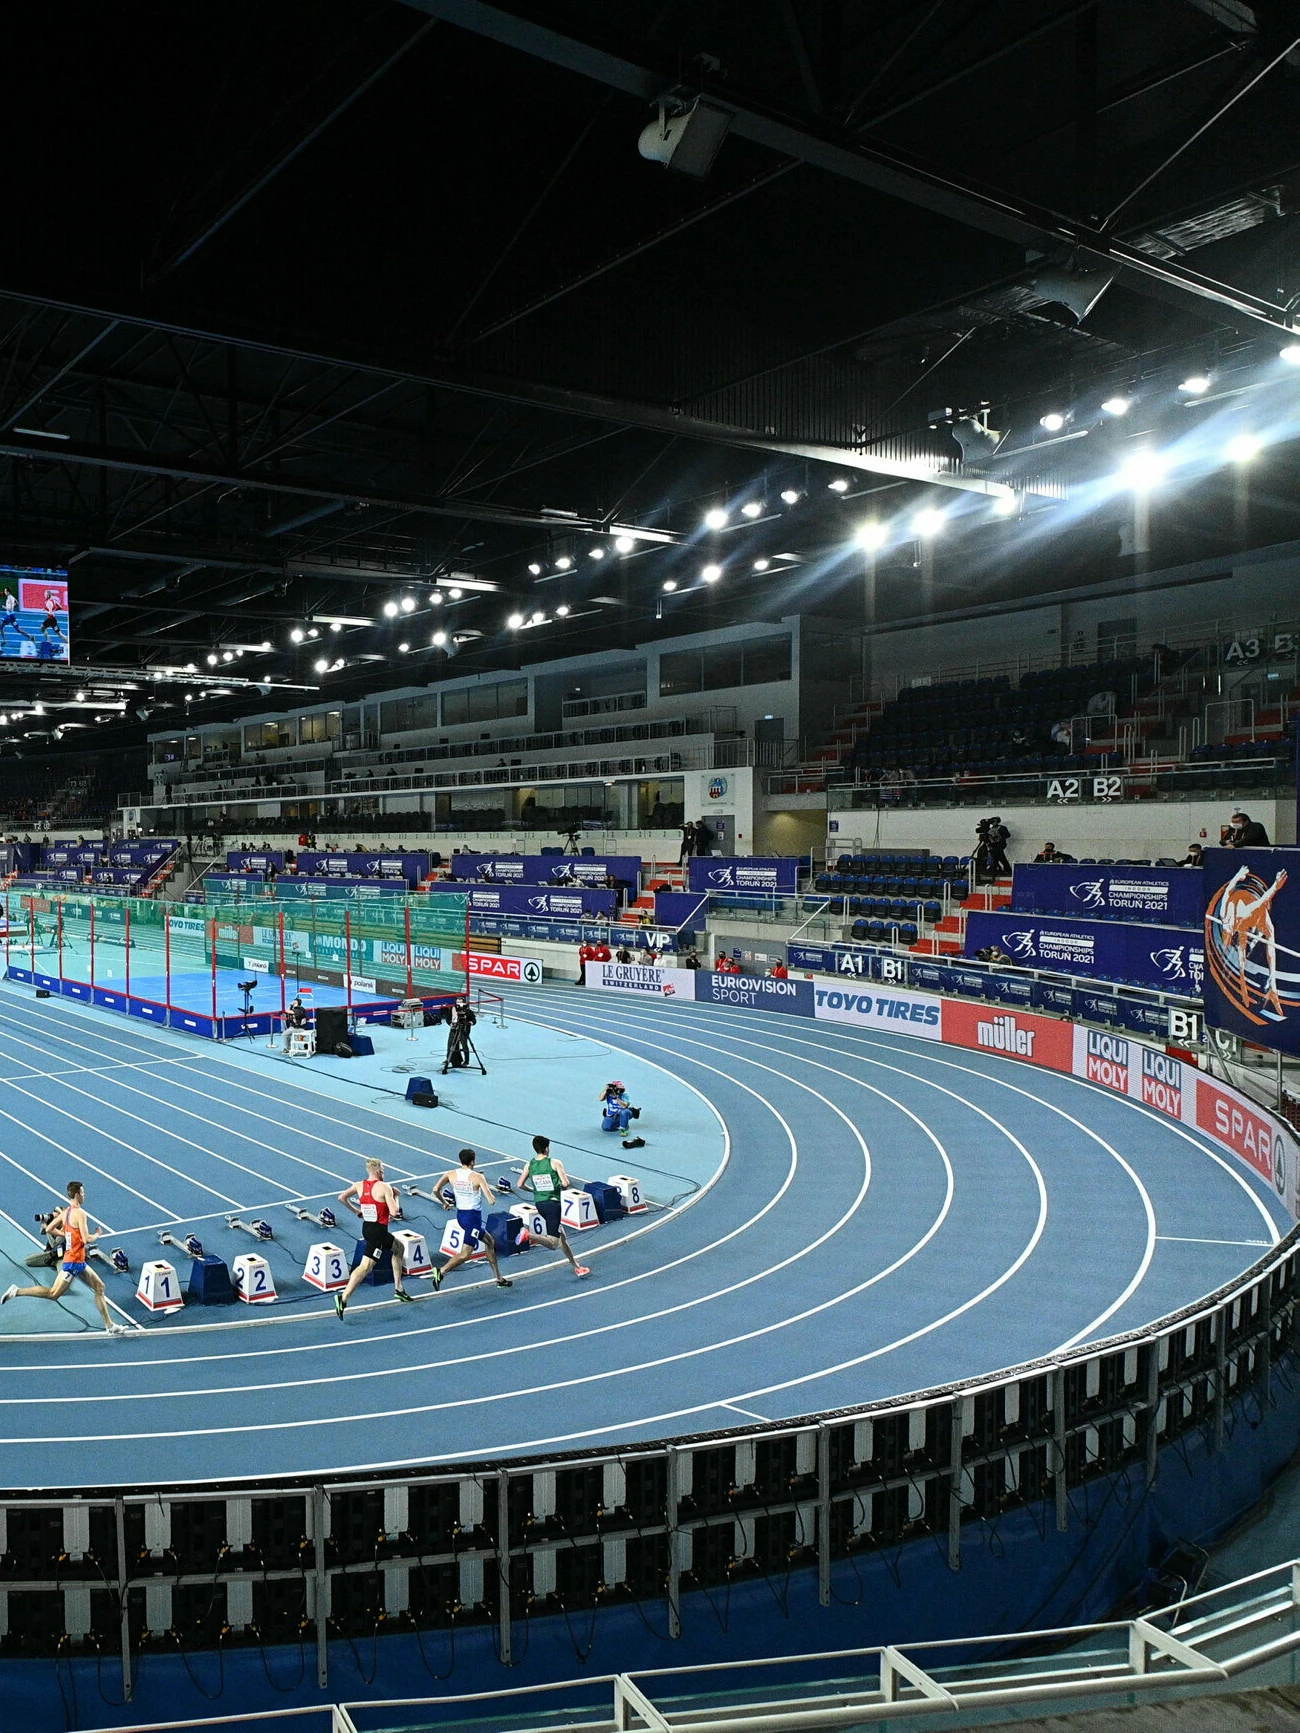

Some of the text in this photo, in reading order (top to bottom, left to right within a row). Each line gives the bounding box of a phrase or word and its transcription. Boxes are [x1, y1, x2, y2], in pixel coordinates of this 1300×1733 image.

[1225, 638, 1260, 661] A3
[1274, 633, 1300, 654] B
[1047, 779, 1079, 798] A2
[1093, 776, 1121, 797] B2
[1108, 892, 1168, 901] CHAMPIONSHIPS
[1144, 901, 1168, 910] 2021
[183, 921, 205, 932] TIRES
[382, 942, 405, 954] LIQUI
[646, 932, 670, 948] VIP
[1039, 942, 1094, 955] CHAMPIONSHIPS
[382, 952, 406, 964] MOLY
[415, 945, 440, 958] LIQUI
[1073, 953, 1095, 964] 2021
[415, 957, 440, 970] MOLY
[467, 957, 521, 977] SPAR
[602, 964, 613, 979] LE
[840, 953, 863, 973] A1
[883, 959, 903, 980] B1
[603, 979, 661, 991] SWITZERLAND
[712, 987, 757, 1005] SPORT
[815, 990, 940, 1026] TOYO TIRES
[1171, 1010, 1197, 1041] B1
[977, 1015, 1036, 1057] müller
[1089, 1030, 1127, 1065] LIQUI
[1088, 1056, 1127, 1092] MOLY
[1143, 1050, 1181, 1088] LIQUI
[1143, 1077, 1181, 1117] MOLY
[1215, 1099, 1271, 1170] SPAR
[631, 1186, 640, 1204] 8
[563, 1199, 574, 1216] 7
[581, 1201, 591, 1220] 7
[533, 1216, 543, 1235] 6
[449, 1230, 460, 1249] 5
[412, 1244, 424, 1265] 4
[311, 1255, 321, 1276] 3
[331, 1258, 342, 1279] 3
[144, 1274, 150, 1294] 1
[160, 1276, 171, 1298] 1
[236, 1267, 245, 1289] 2
[254, 1269, 267, 1292] 2
